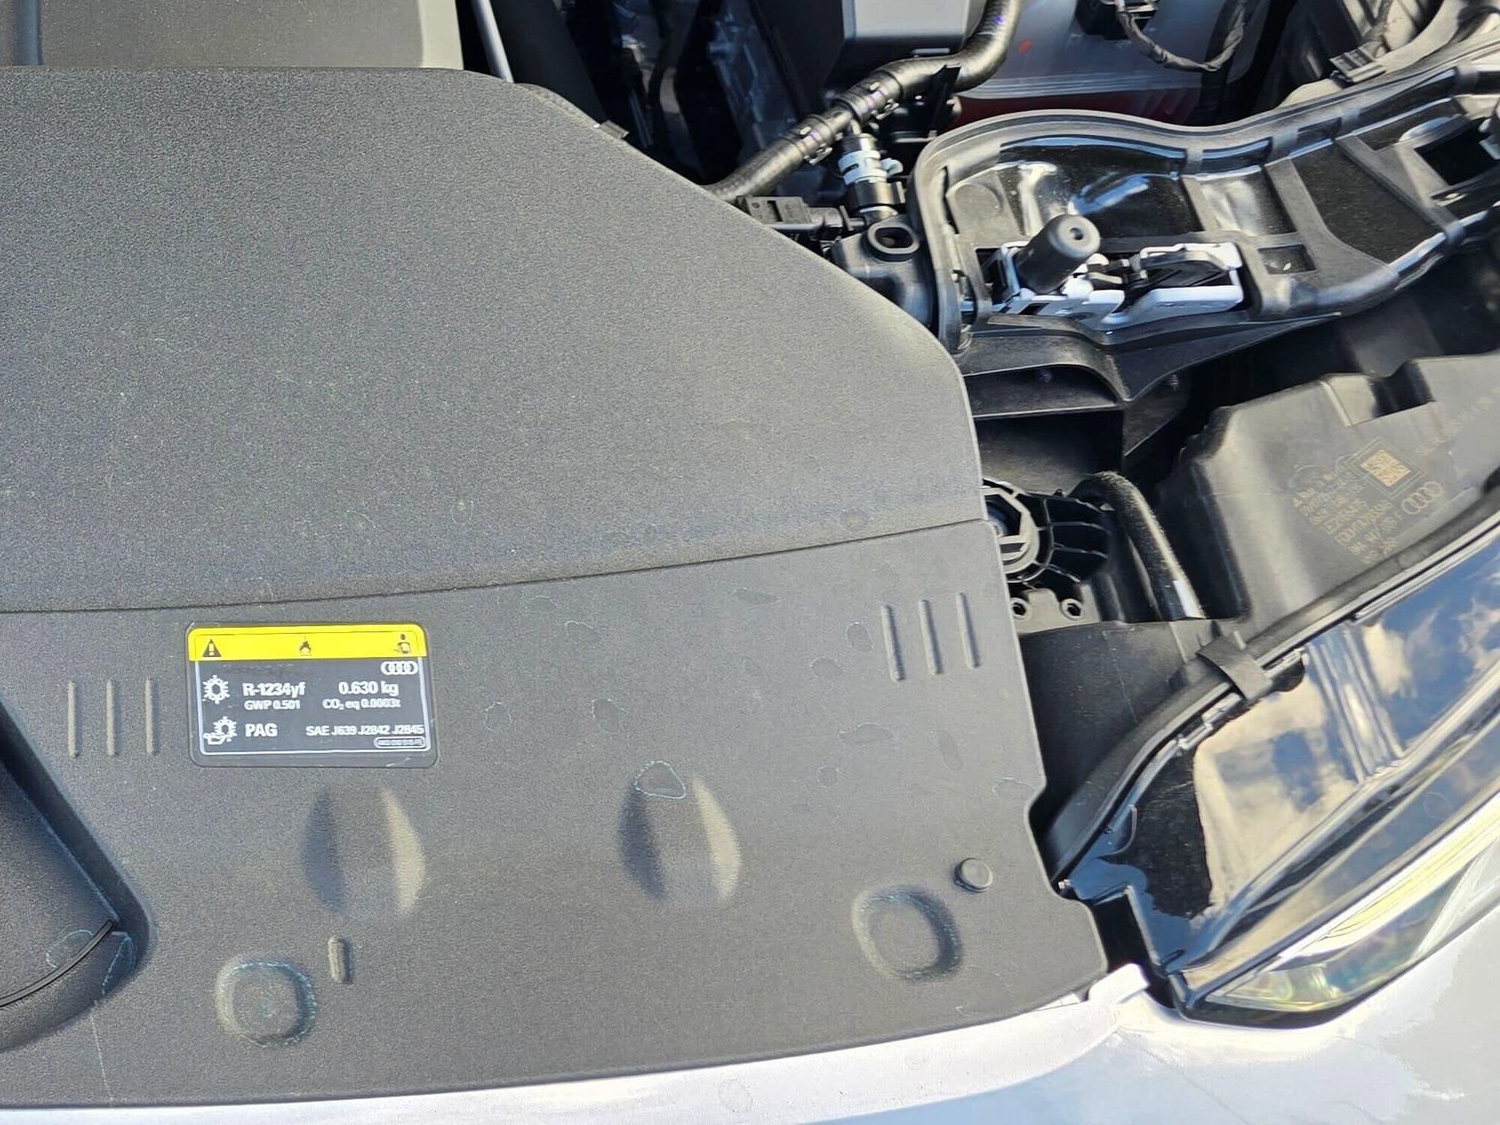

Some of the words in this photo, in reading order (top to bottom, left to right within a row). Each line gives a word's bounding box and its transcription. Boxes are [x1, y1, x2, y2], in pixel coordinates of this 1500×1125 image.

[242, 682, 306, 698] R-1234yf
[338, 681, 379, 695] 0.630
[380, 681, 399, 697] kg
[244, 700, 272, 710] GWP
[273, 700, 300, 710] 0.501
[345, 700, 360, 710] eq
[245, 723, 278, 737] PAG
[306, 725, 330, 736] SAE
[331, 725, 357, 735] J639
[358, 725, 390, 735] J2842
[392, 724, 425, 735] J2845
